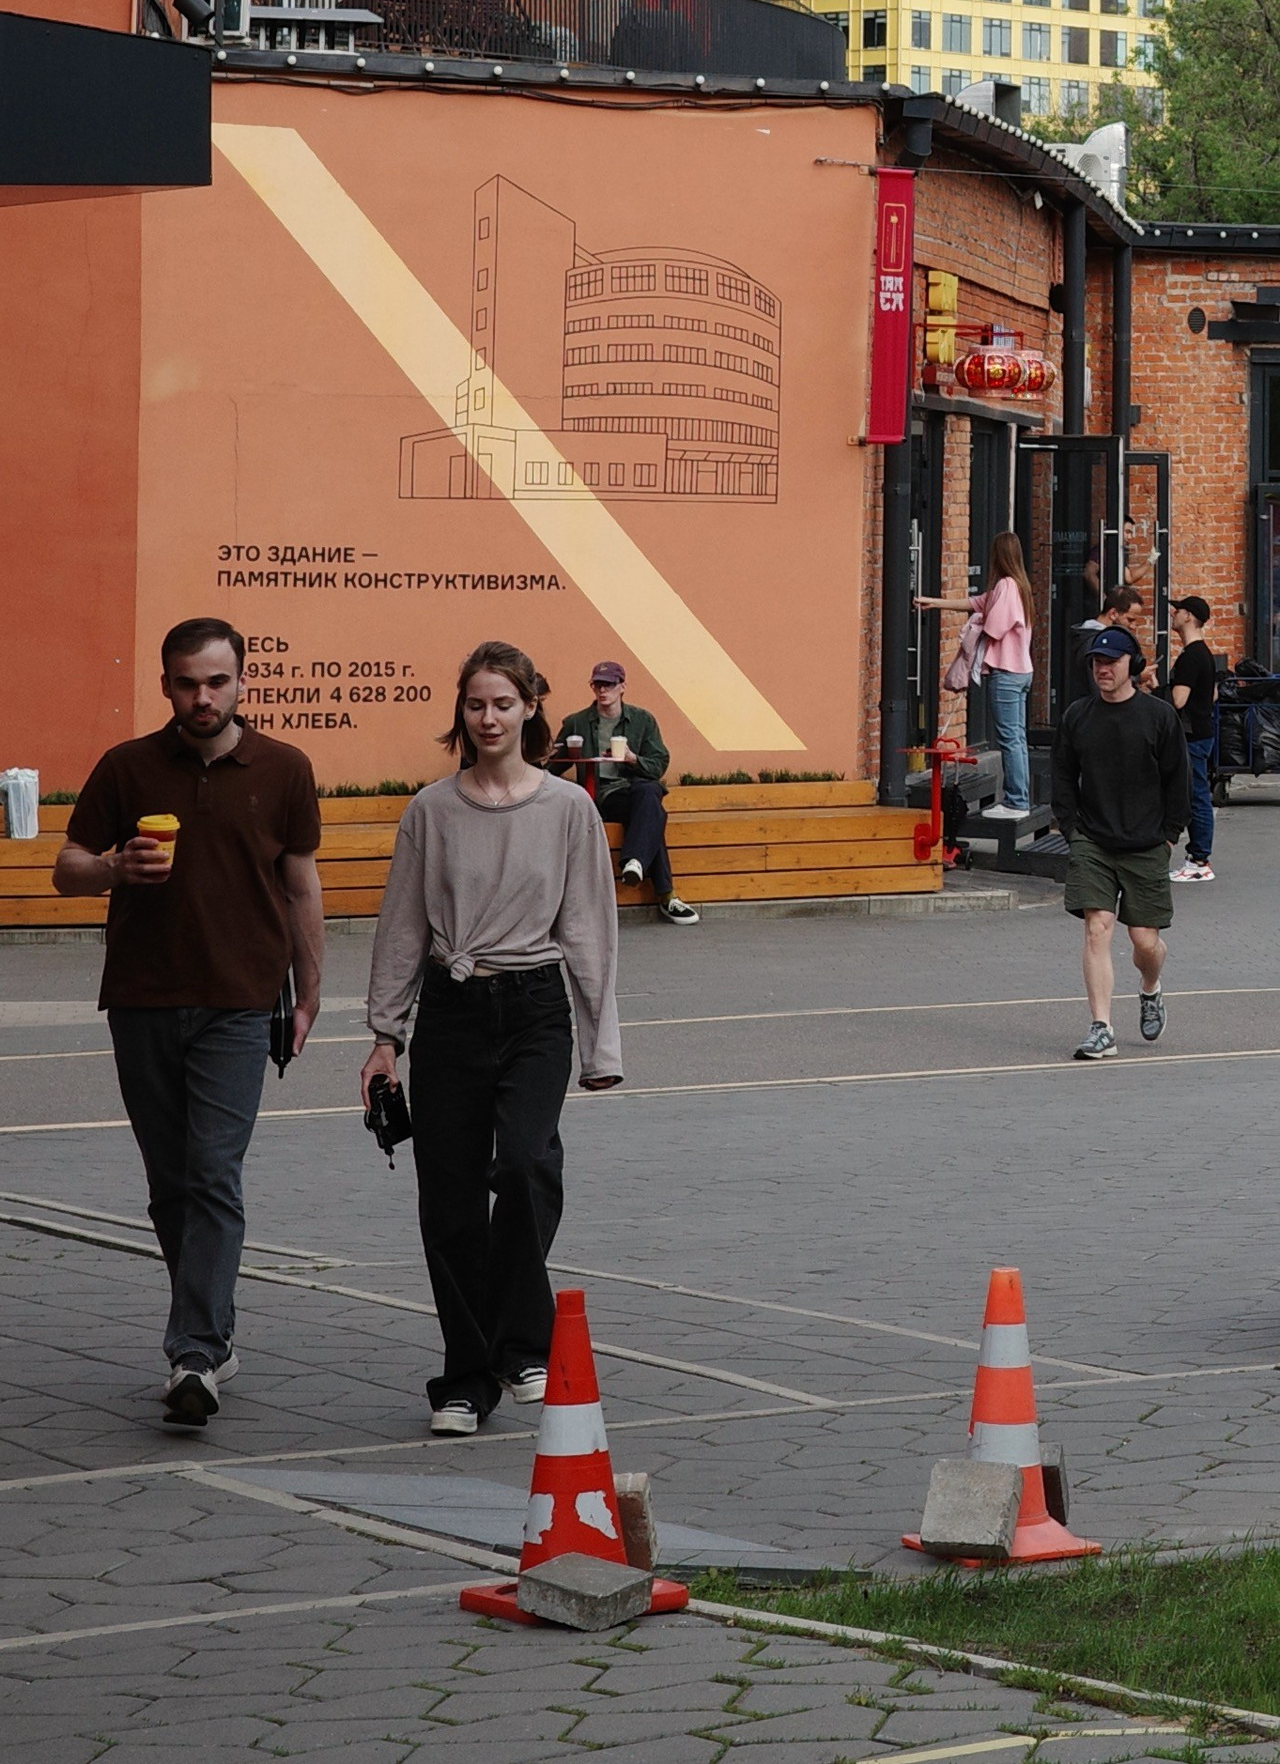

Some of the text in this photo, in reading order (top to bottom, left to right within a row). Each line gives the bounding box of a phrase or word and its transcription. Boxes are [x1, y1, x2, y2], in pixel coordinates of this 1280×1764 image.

[217, 545, 261, 562] ЭТО
[267, 545, 356, 566] ЗДАНИЕ
[217, 570, 566, 591] ПАМЯТНИК КОНСТРУКТИВИЗМА.
[246, 636, 289, 653] ЕСЬ
[247, 661, 416, 679] 934 г. ПО 2015 г.
[238, 685, 432, 704] ПЕКЛИ 4 628 200
[245, 712, 358, 730] НН ХЛЕБА.
